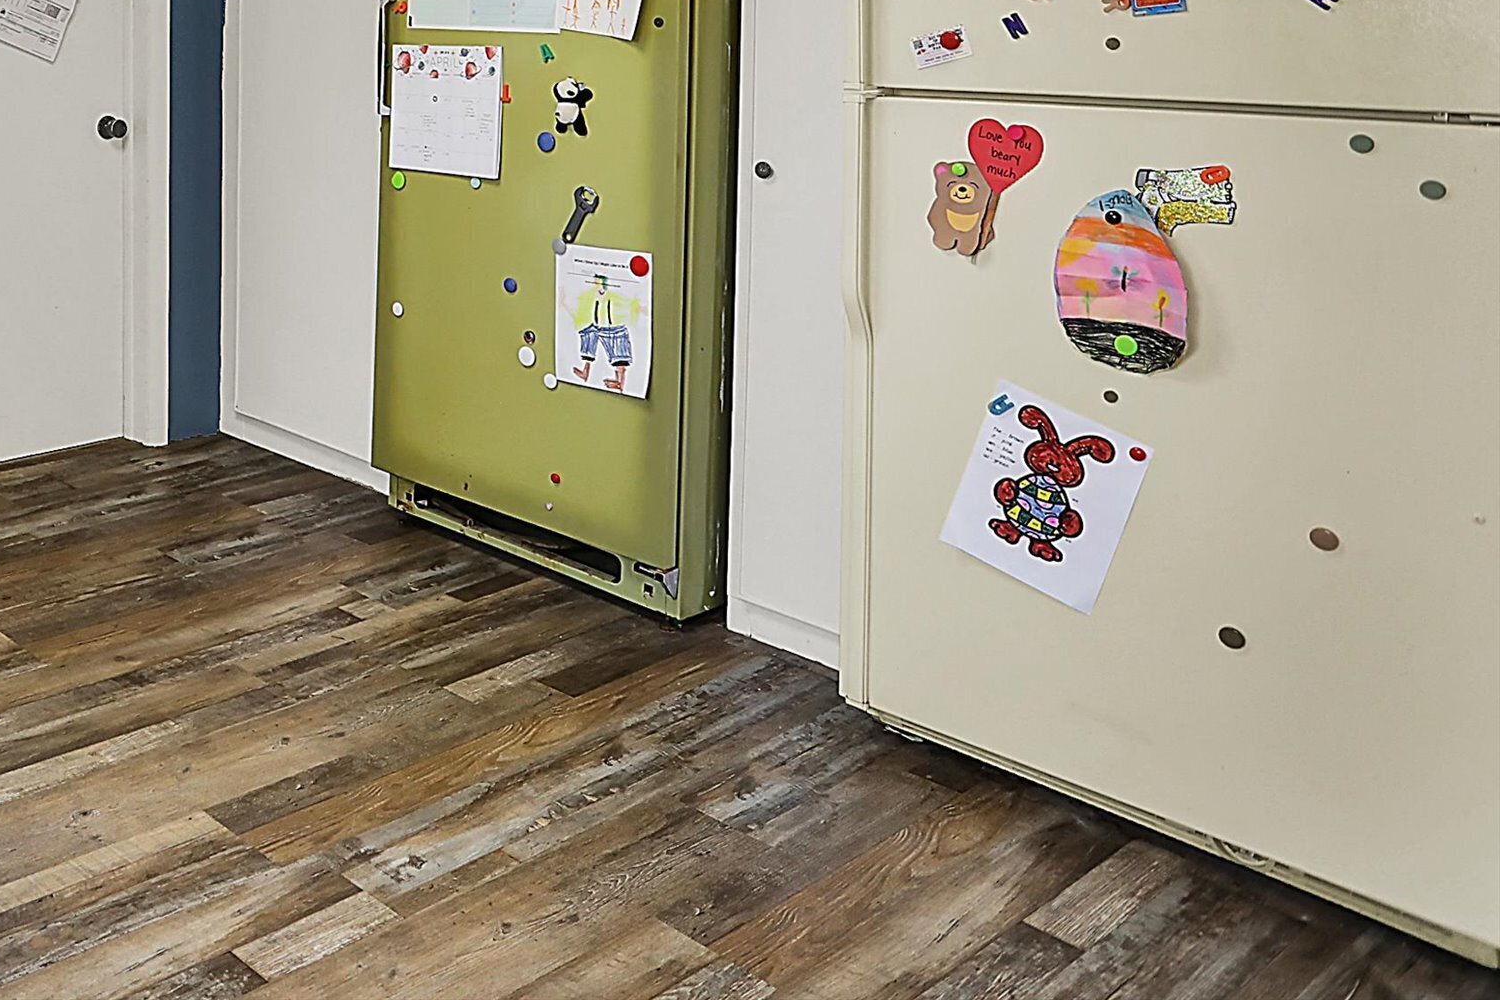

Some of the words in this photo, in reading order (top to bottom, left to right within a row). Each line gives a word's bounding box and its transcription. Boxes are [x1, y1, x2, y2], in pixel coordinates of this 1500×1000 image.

[978, 125, 1003, 143] Love
[991, 146, 1021, 166] beary
[987, 164, 1016, 179] much
